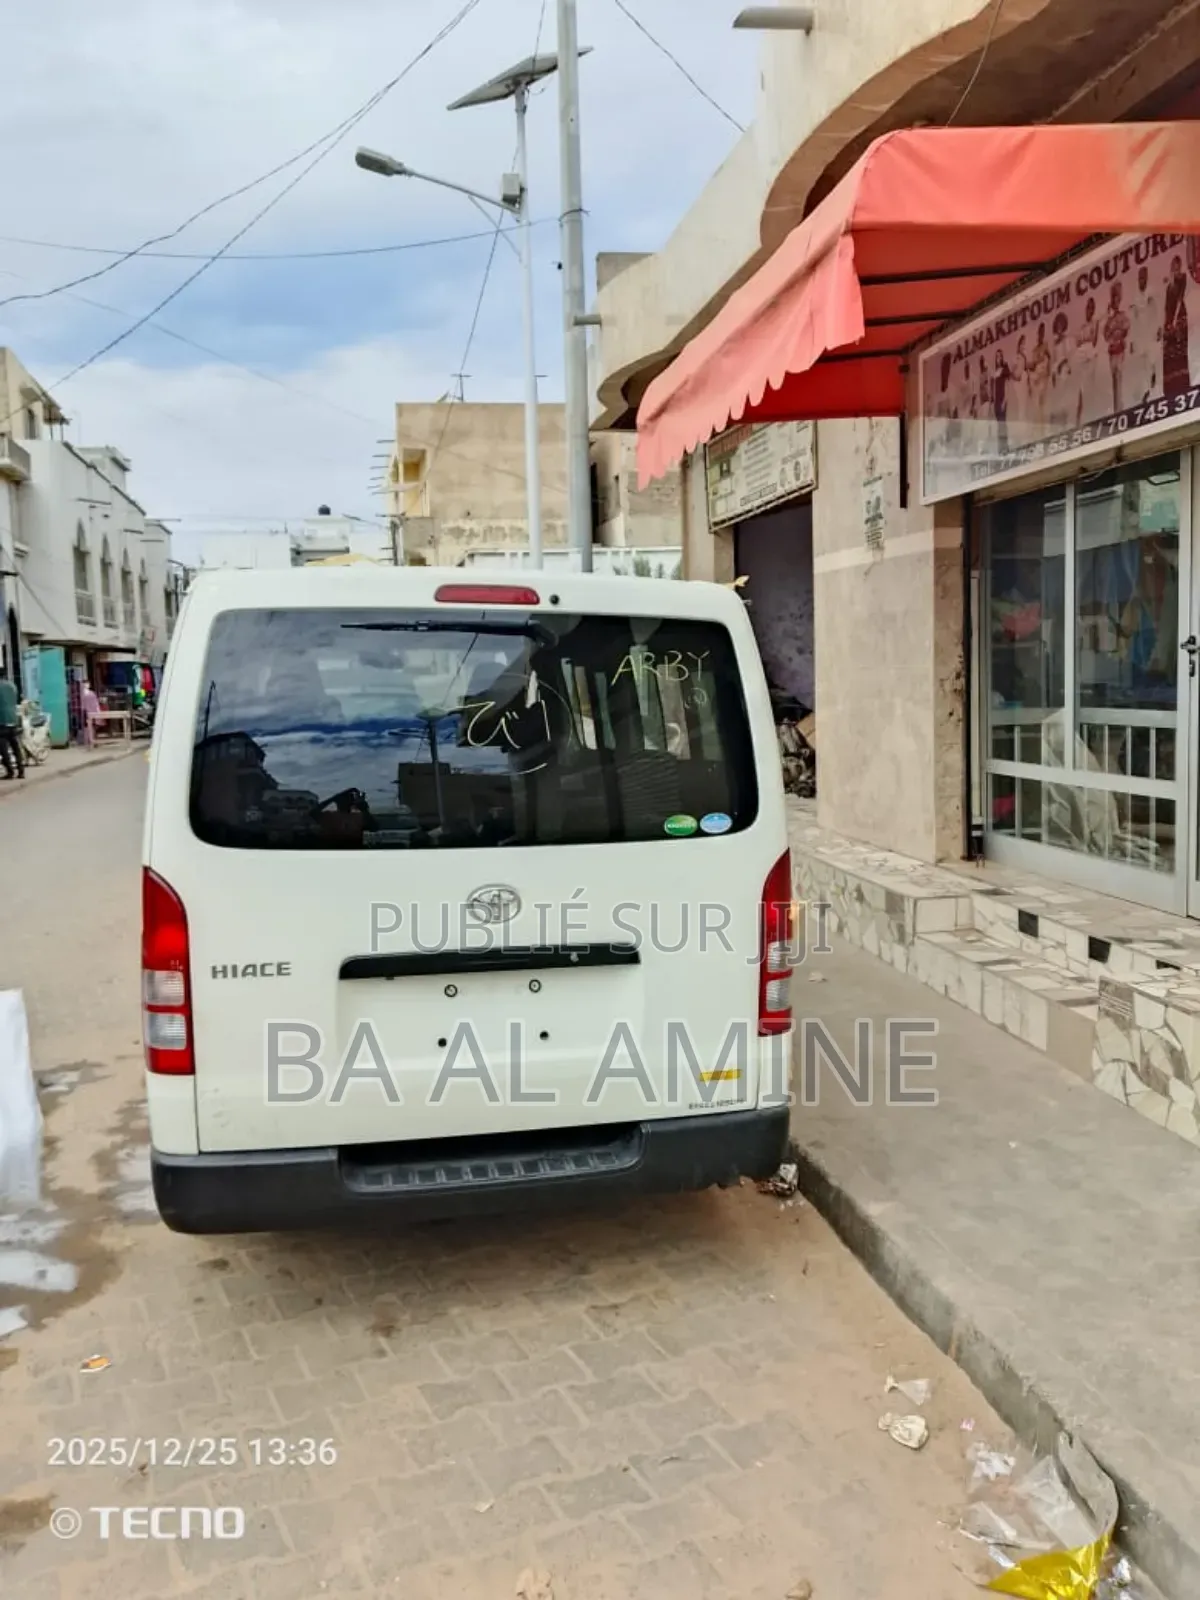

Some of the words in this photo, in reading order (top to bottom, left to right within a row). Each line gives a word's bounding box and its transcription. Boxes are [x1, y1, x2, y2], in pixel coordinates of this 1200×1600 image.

[953, 281, 1069, 364] ALMAKHTOUM
[1107, 414, 1128, 435] 70
[1133, 400, 1169, 425] 745
[1174, 389, 1199, 412] 37
[611, 650, 710, 686] ARBY
[211, 961, 292, 979] HIACE
